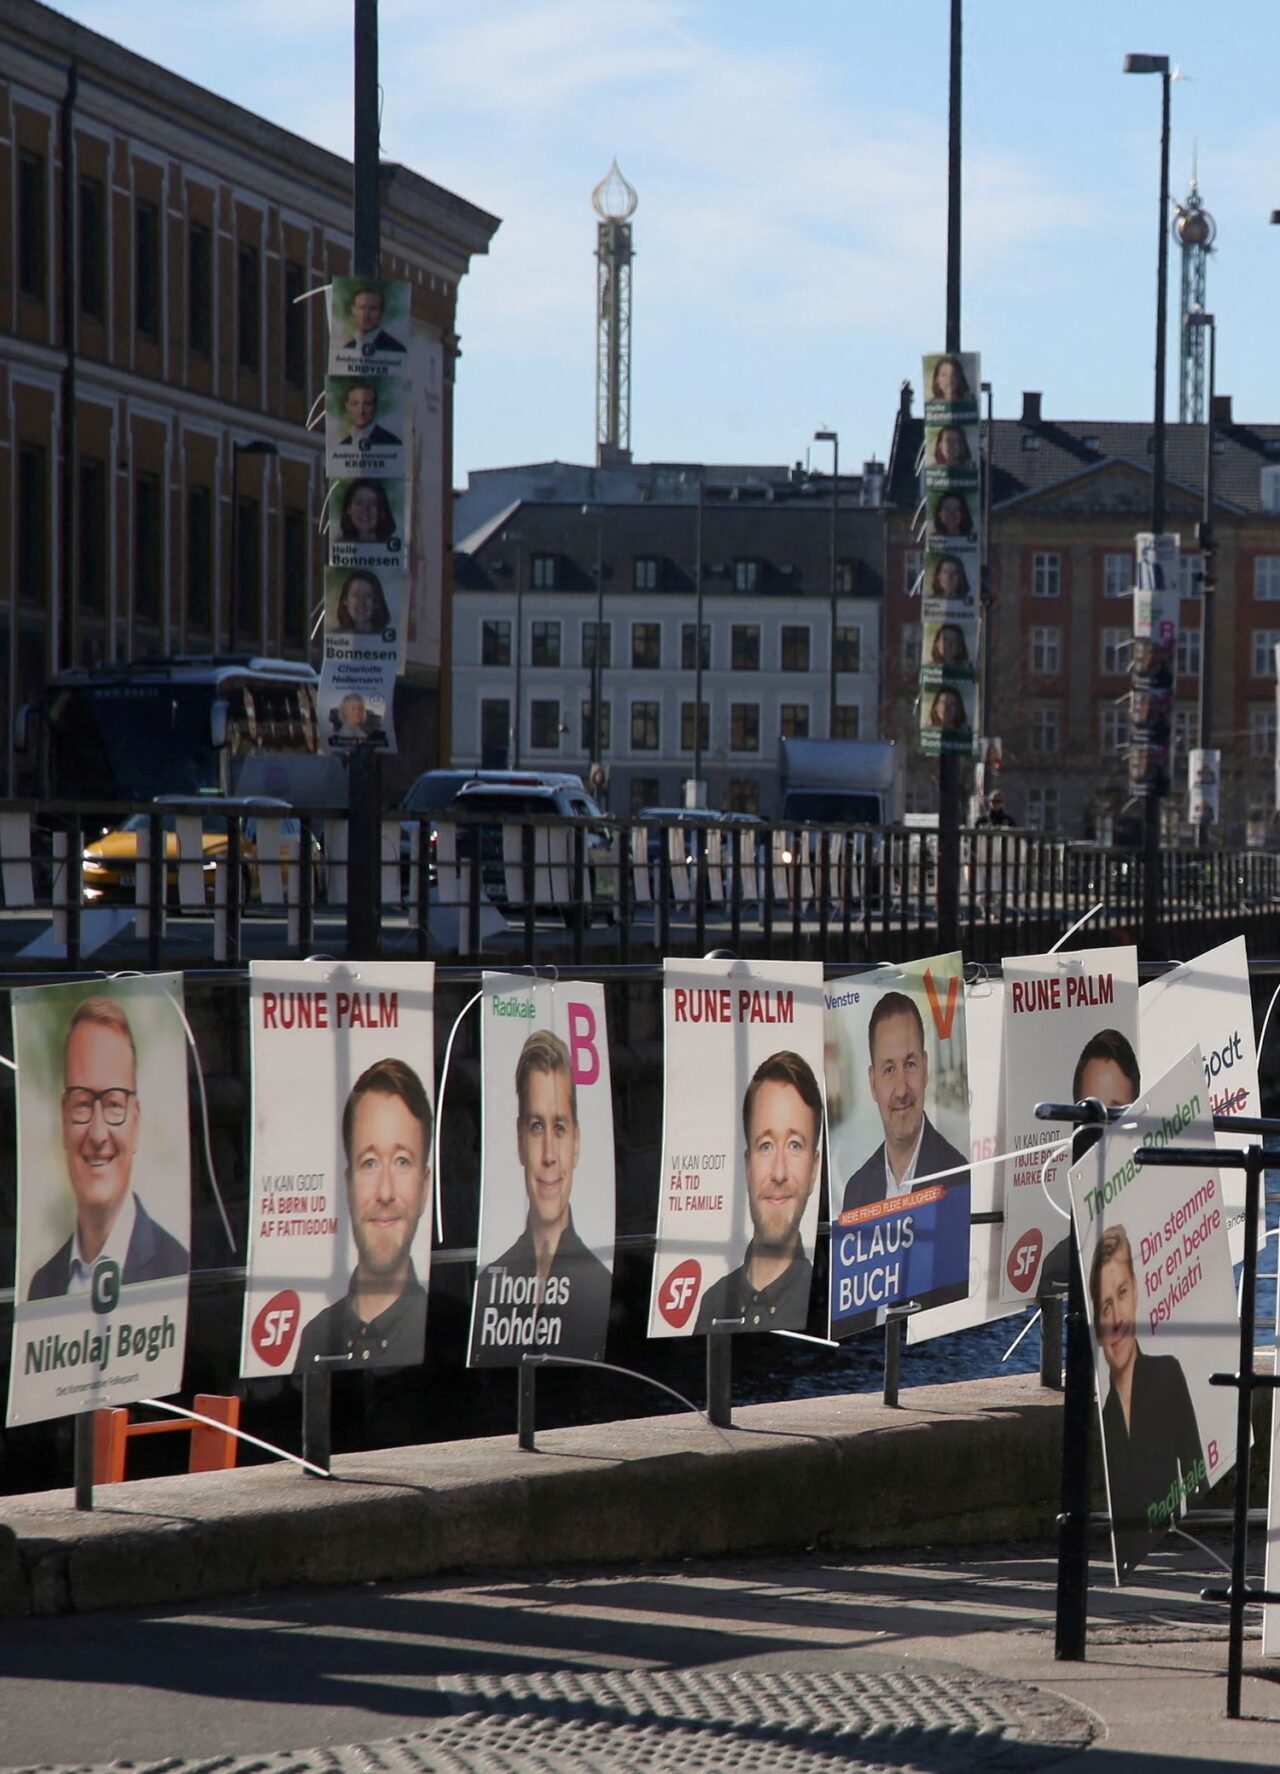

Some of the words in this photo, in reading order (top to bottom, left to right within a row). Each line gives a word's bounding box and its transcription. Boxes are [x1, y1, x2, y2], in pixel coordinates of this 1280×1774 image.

[331, 555, 400, 567] Bonnesen
[326, 648, 398, 660] Bonnesen
[492, 994, 536, 1019] Radikale
[674, 989, 731, 1023] RUNE
[739, 990, 794, 1024] PALM
[824, 990, 861, 1010] Venstre
[922, 966, 961, 1041] V
[1012, 978, 1061, 1014] RUNE
[1066, 972, 1114, 1009] PALM
[263, 992, 328, 1029] RUNE
[335, 992, 399, 1029] PALM
[567, 1001, 601, 1087] B
[1014, 1135, 1021, 1150] VI
[1023, 1133, 1038, 1148] KAN
[671, 1155, 681, 1171] VI
[682, 1155, 700, 1171] KAN
[701, 1154, 727, 1171] GODT
[1013, 1167, 1057, 1187] MARKEET
[262, 1174, 273, 1192] VI
[274, 1174, 295, 1192] KAN
[296, 1173, 325, 1191] GODT
[670, 1171, 683, 1191] FÅ
[684, 1174, 701, 1191] TID
[1083, 1155, 1144, 1223] Thomas
[261, 1192, 275, 1216] FÅ
[277, 1197, 308, 1215] BØRN
[310, 1195, 326, 1213] UD
[669, 1196, 683, 1212] TIL
[685, 1195, 724, 1212] FAMILIE
[259, 1220, 275, 1239] AF
[276, 1216, 339, 1238] FATTIGDOM
[1139, 1231, 1163, 1266] Din
[1164, 1177, 1216, 1235] stemme
[840, 1216, 914, 1267] CLAUS
[1145, 1267, 1163, 1299] for
[1165, 1247, 1183, 1278] en
[1184, 1207, 1222, 1260] bedre
[1013, 1245, 1038, 1277] SF
[487, 1266, 570, 1305] Thomas
[665, 1277, 696, 1311] SF
[839, 1262, 900, 1312] BUCH
[1149, 1256, 1203, 1336] psykiatri
[260, 1309, 295, 1347] SF
[481, 1307, 562, 1346] Rohden
[25, 1325, 112, 1376] Nikolaj
[117, 1315, 175, 1362] Bøgh
[1207, 1440, 1219, 1470] B
